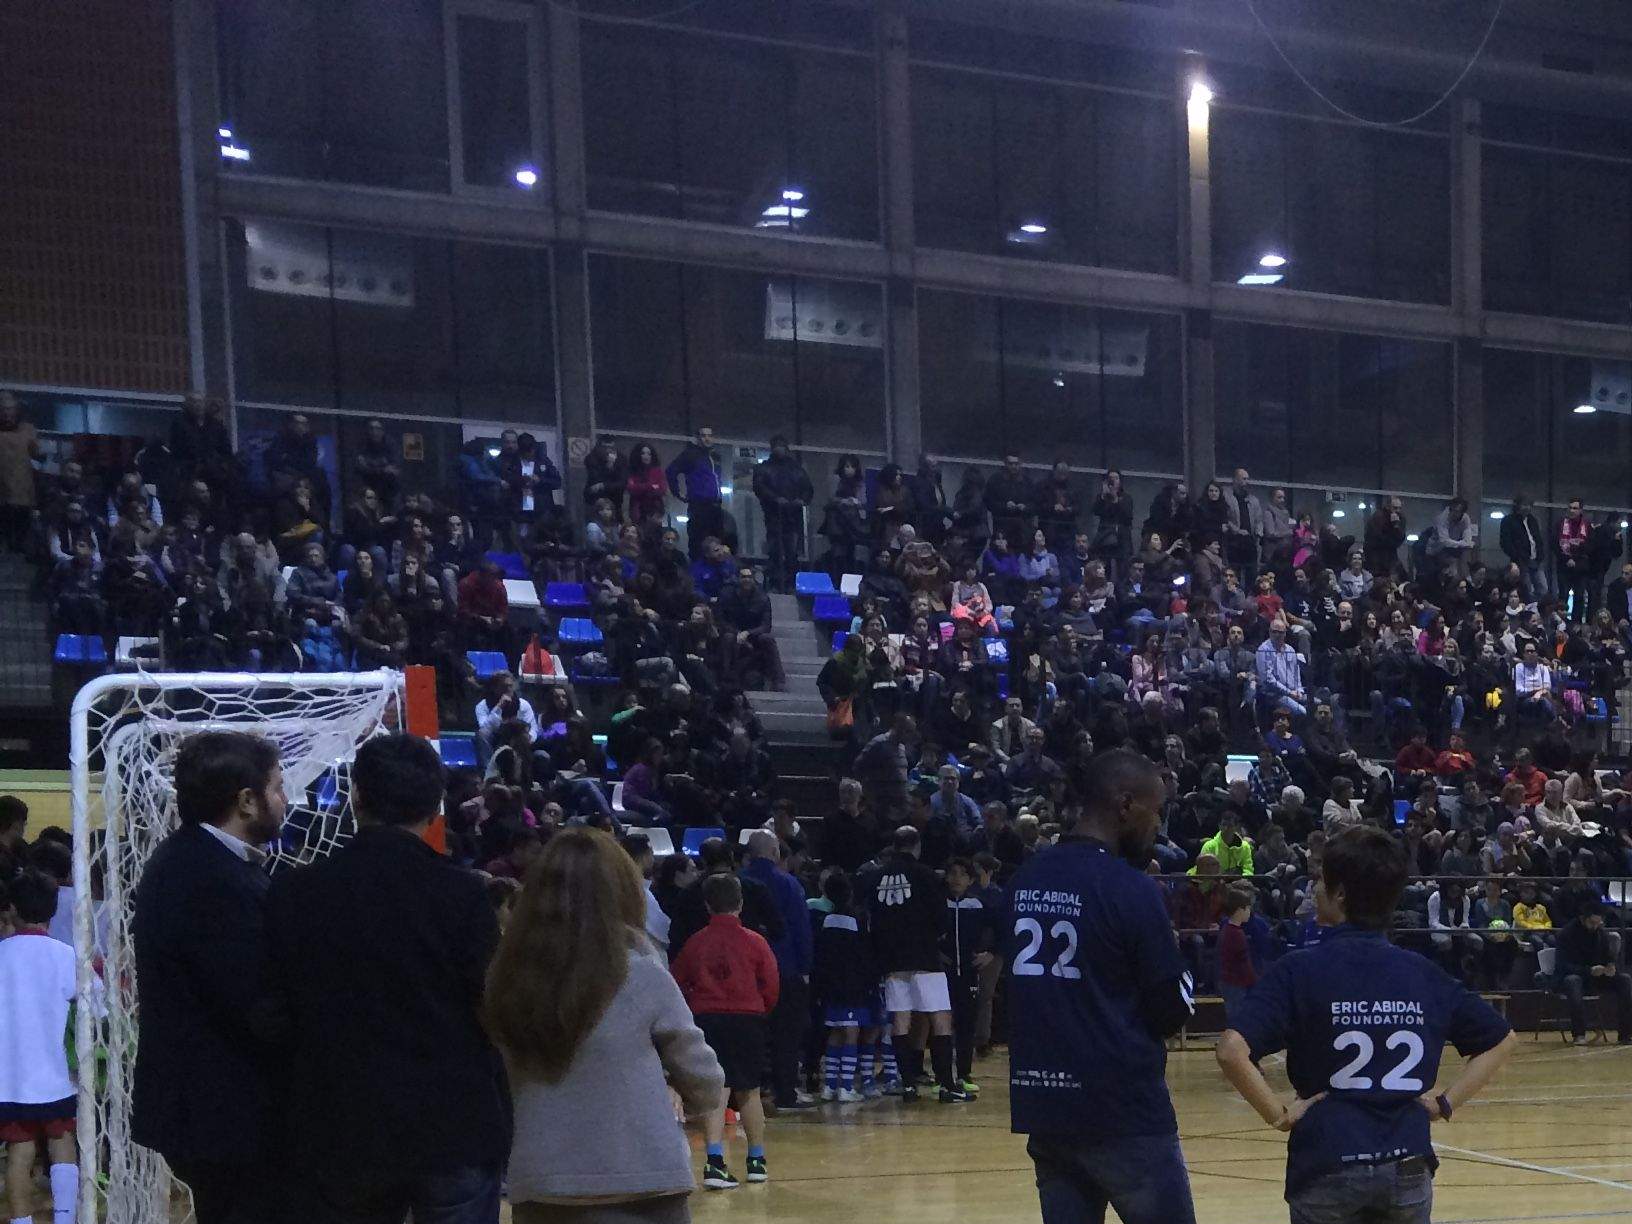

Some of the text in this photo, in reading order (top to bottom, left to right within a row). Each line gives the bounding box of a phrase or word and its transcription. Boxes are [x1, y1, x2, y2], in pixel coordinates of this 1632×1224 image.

[1041, 890, 1082, 906] ABIDAL
[1012, 917, 1082, 979] 22
[1331, 1001, 1424, 1014] ERIC ABIDAL
[1332, 1014, 1424, 1026] FOUNDATION
[1329, 1030, 1424, 1091] 22
